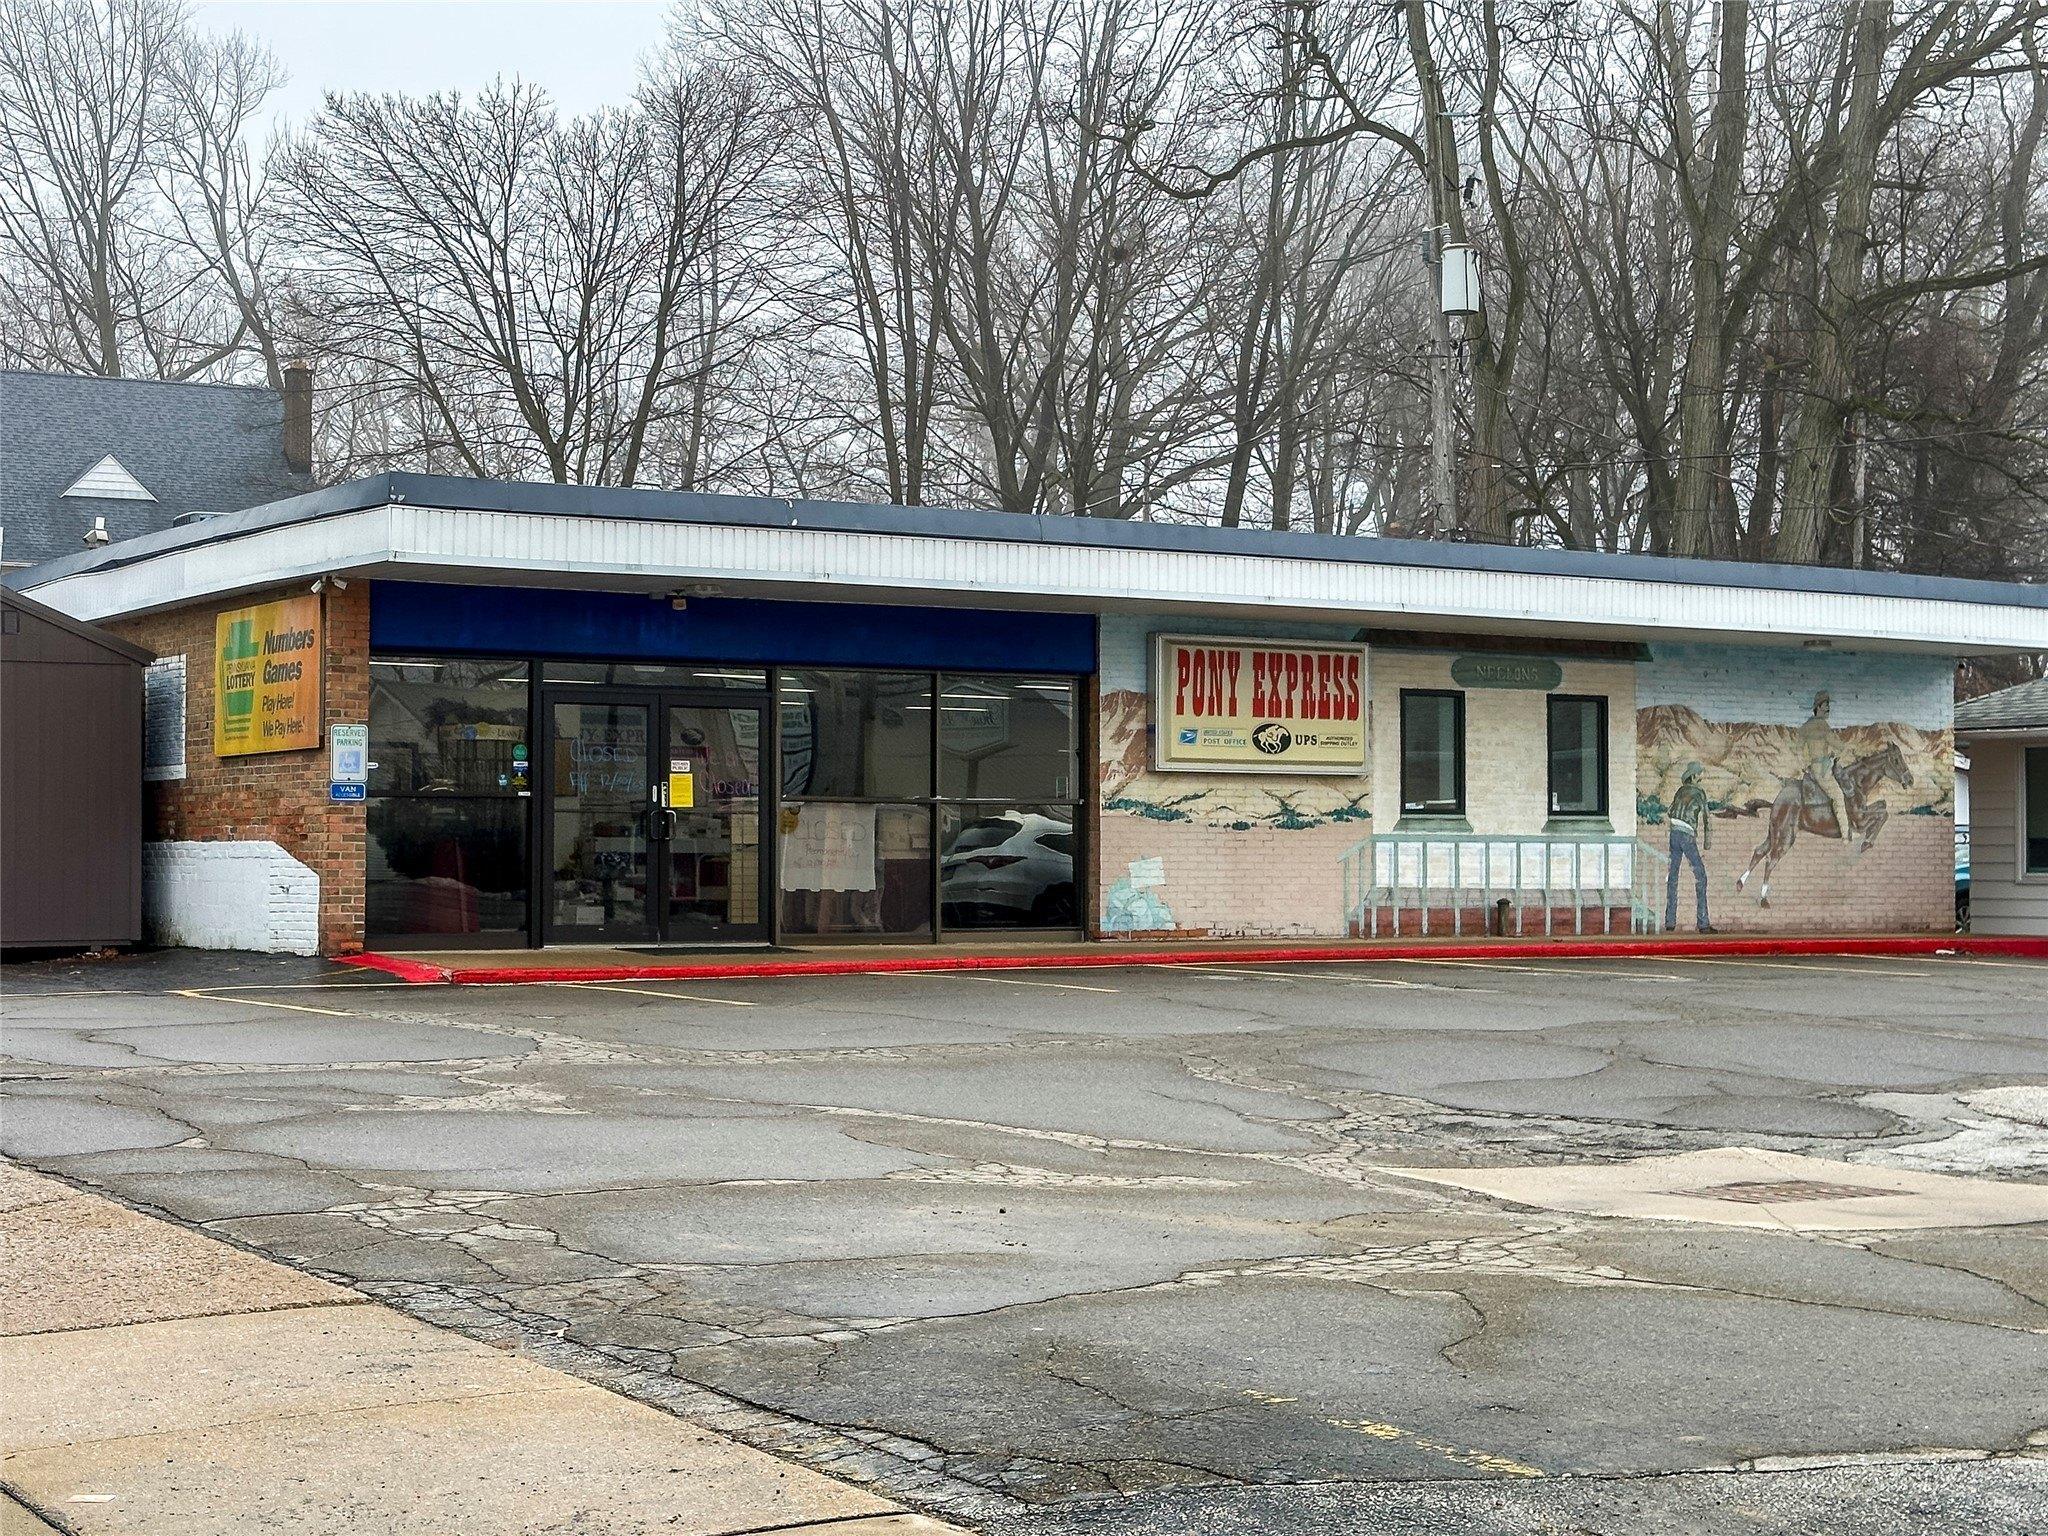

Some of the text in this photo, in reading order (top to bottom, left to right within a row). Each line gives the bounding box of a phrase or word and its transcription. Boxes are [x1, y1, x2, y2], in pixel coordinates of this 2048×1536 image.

[262, 626, 315, 656] Numbers
[226, 671, 256, 691] LOTTERY
[262, 658, 303, 685] Games
[1175, 648, 1360, 721] PONY EXPRESS
[262, 692, 295, 715] Play Here!
[262, 716, 305, 739] We Pay Here!
[333, 728, 366, 737] RESERVED
[336, 738, 363, 747] PARKING
[1224, 738, 1247, 746] OFFICE
[1295, 734, 1317, 746] UPS
[340, 785, 357, 793] VAN
